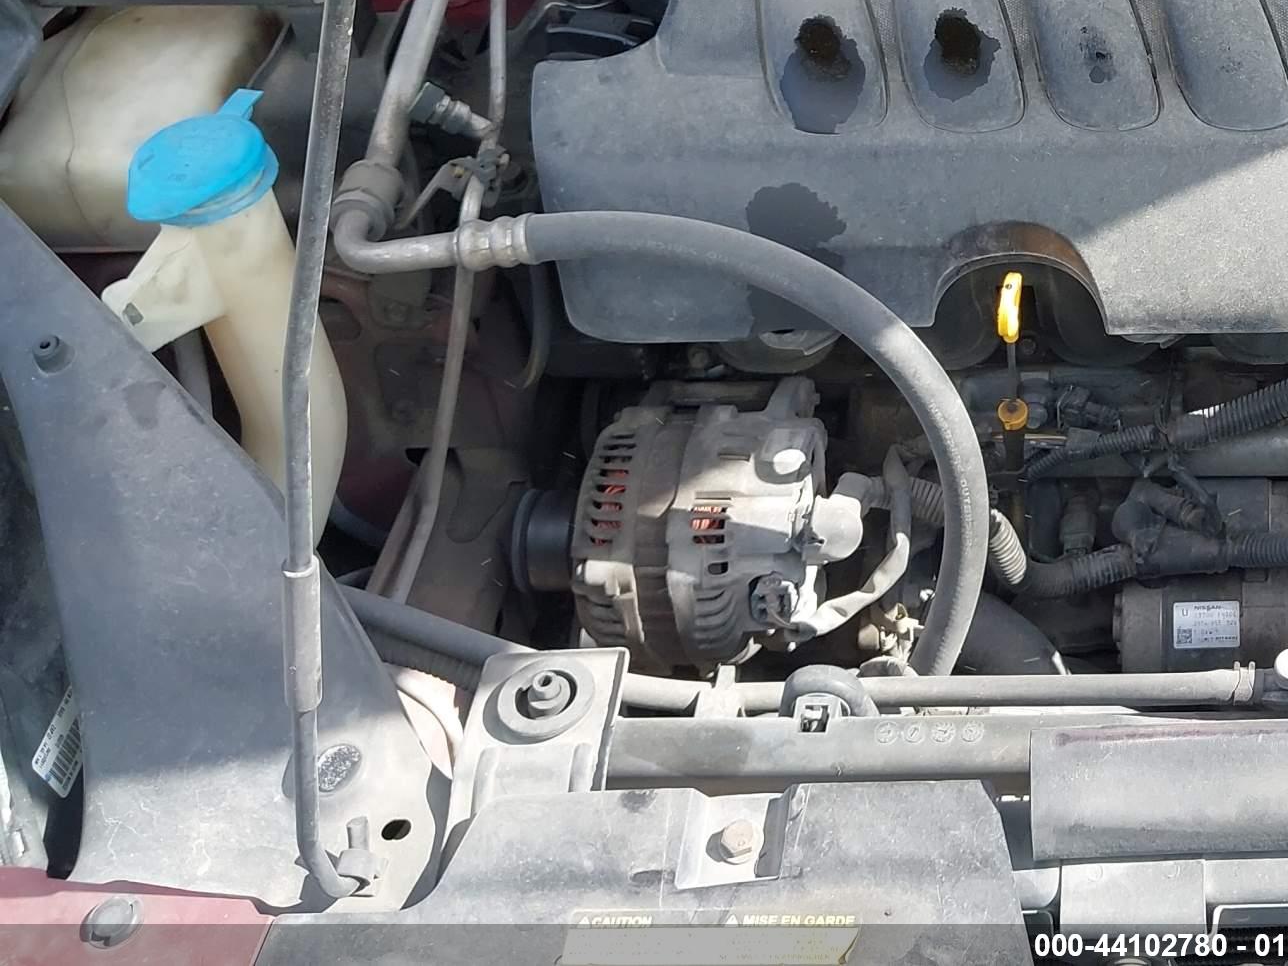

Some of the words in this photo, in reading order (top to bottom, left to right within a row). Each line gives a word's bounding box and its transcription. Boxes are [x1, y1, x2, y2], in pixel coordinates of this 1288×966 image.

[592, 916, 653, 928] CAUTION
[742, 914, 777, 927] MISE
[781, 914, 800, 927] EN
[804, 914, 856, 927] GARDE
